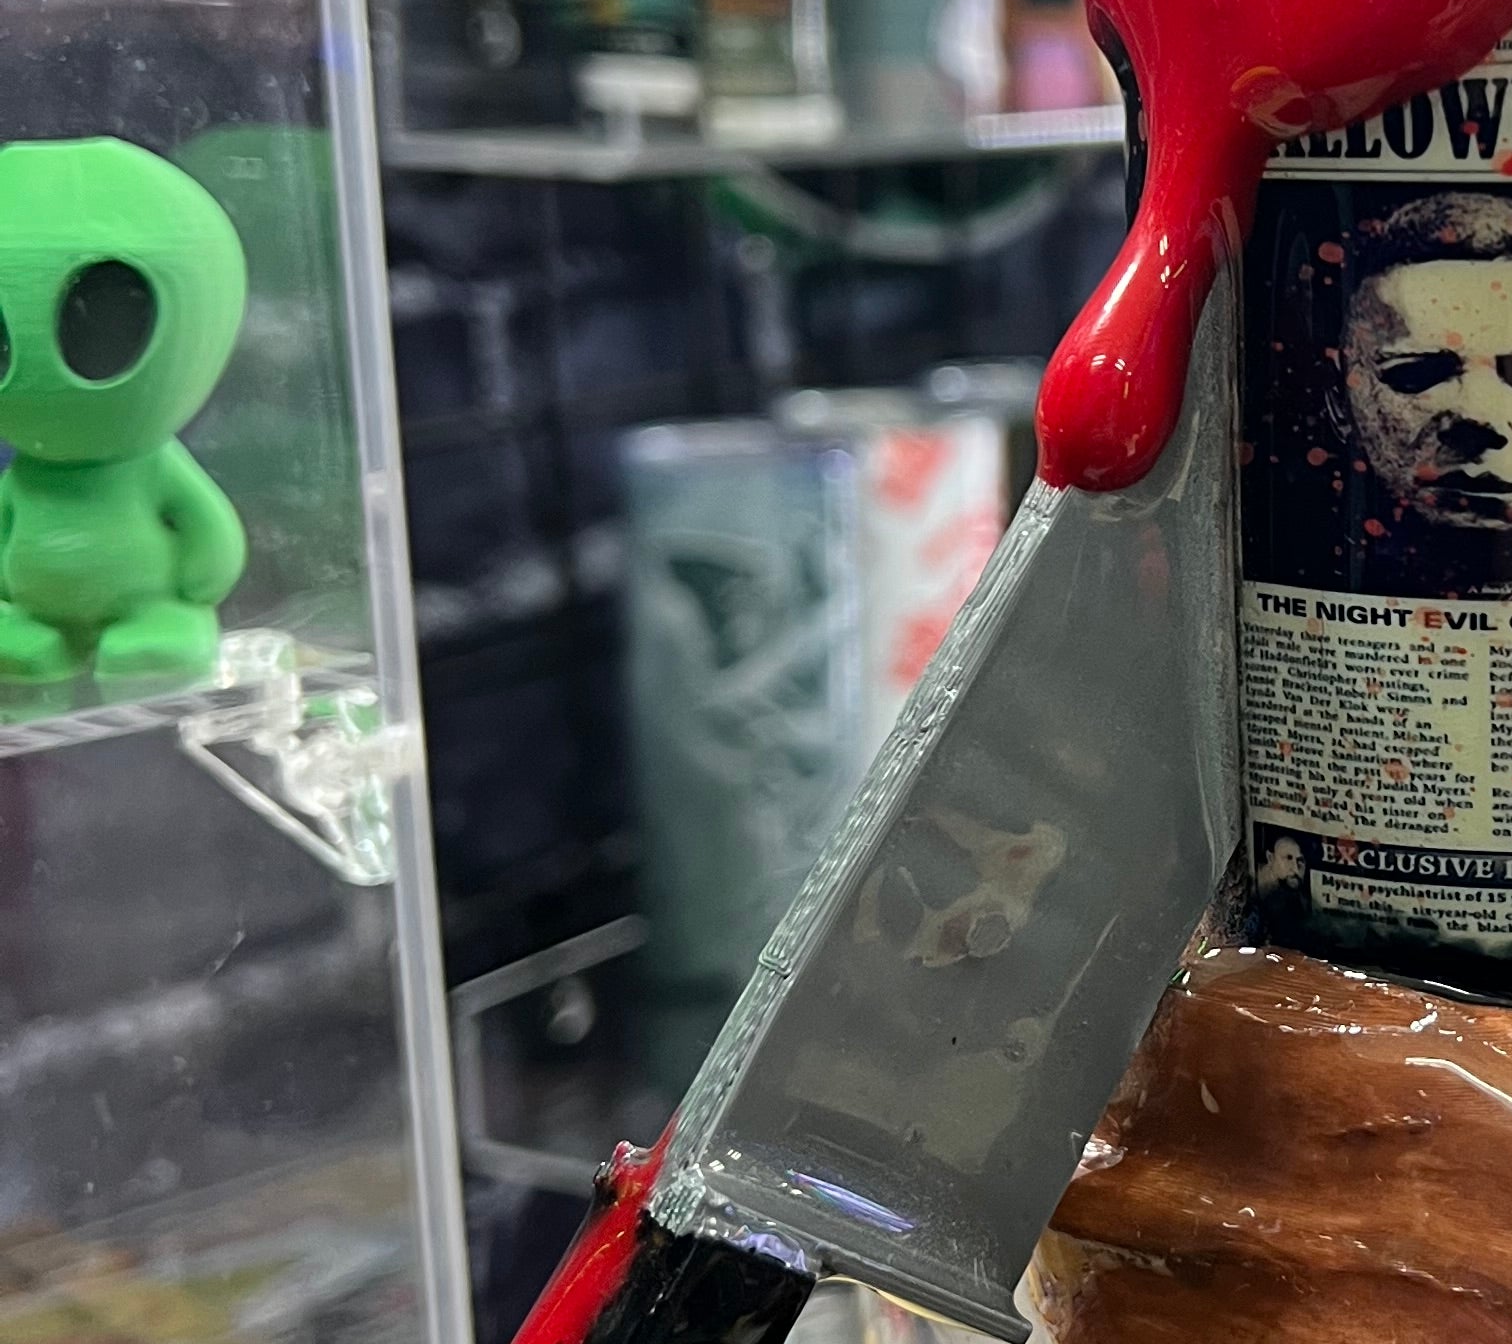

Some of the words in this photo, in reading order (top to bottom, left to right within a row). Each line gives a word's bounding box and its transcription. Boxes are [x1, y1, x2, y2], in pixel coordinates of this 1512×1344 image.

[1258, 592, 1308, 619] THE
[1316, 601, 1414, 629] NIGHT
[1424, 609, 1499, 632] EVIL
[1301, 629, 1331, 643] three
[1338, 636, 1400, 652] teenagers
[1409, 643, 1435, 653] and
[1309, 645, 1336, 657] were
[1345, 650, 1409, 664] murdered
[1441, 657, 1467, 666] one
[1288, 667, 1357, 685] Christopher
[1390, 668, 1419, 678] ever
[1429, 670, 1469, 681] crime
[1283, 690, 1303, 702] Van
[1310, 695, 1331, 707] Der
[1339, 699, 1369, 711] Klok
[1388, 692, 1432, 704] Simms
[1442, 696, 1467, 706] and
[1347, 713, 1385, 726] hands
[1393, 717, 1408, 729] of
[1416, 721, 1432, 729] an
[1354, 738, 1376, 750] had
[1384, 744, 1440, 757] escaped
[1393, 731, 1449, 745] Michael
[1332, 748, 1402, 765] Sanitarium
[1327, 761, 1347, 773] the
[1455, 773, 1476, 784] for
[1490, 762, 1510, 774] be
[1249, 772, 1280, 786] Myers
[1312, 785, 1338, 798] only
[1361, 792, 1396, 804] years
[1404, 795, 1426, 806] old
[1435, 797, 1474, 809] when
[1309, 770, 1325, 782] his
[1377, 779, 1418, 792] Judith
[1355, 800, 1374, 814] his
[1382, 803, 1419, 818] sister
[1428, 809, 1446, 819] on
[1354, 814, 1377, 827] The
[1385, 816, 1449, 833] deranged
[1492, 828, 1511, 838] on
[1322, 842, 1495, 879] EXCLUSIVE
[1322, 874, 1364, 893] Myers
[1368, 884, 1460, 902] psychiatrist
[1464, 891, 1483, 903] of
[1488, 892, 1505, 904] 15
[1412, 906, 1497, 920] six-year-old
[1447, 921, 1468, 932] the
